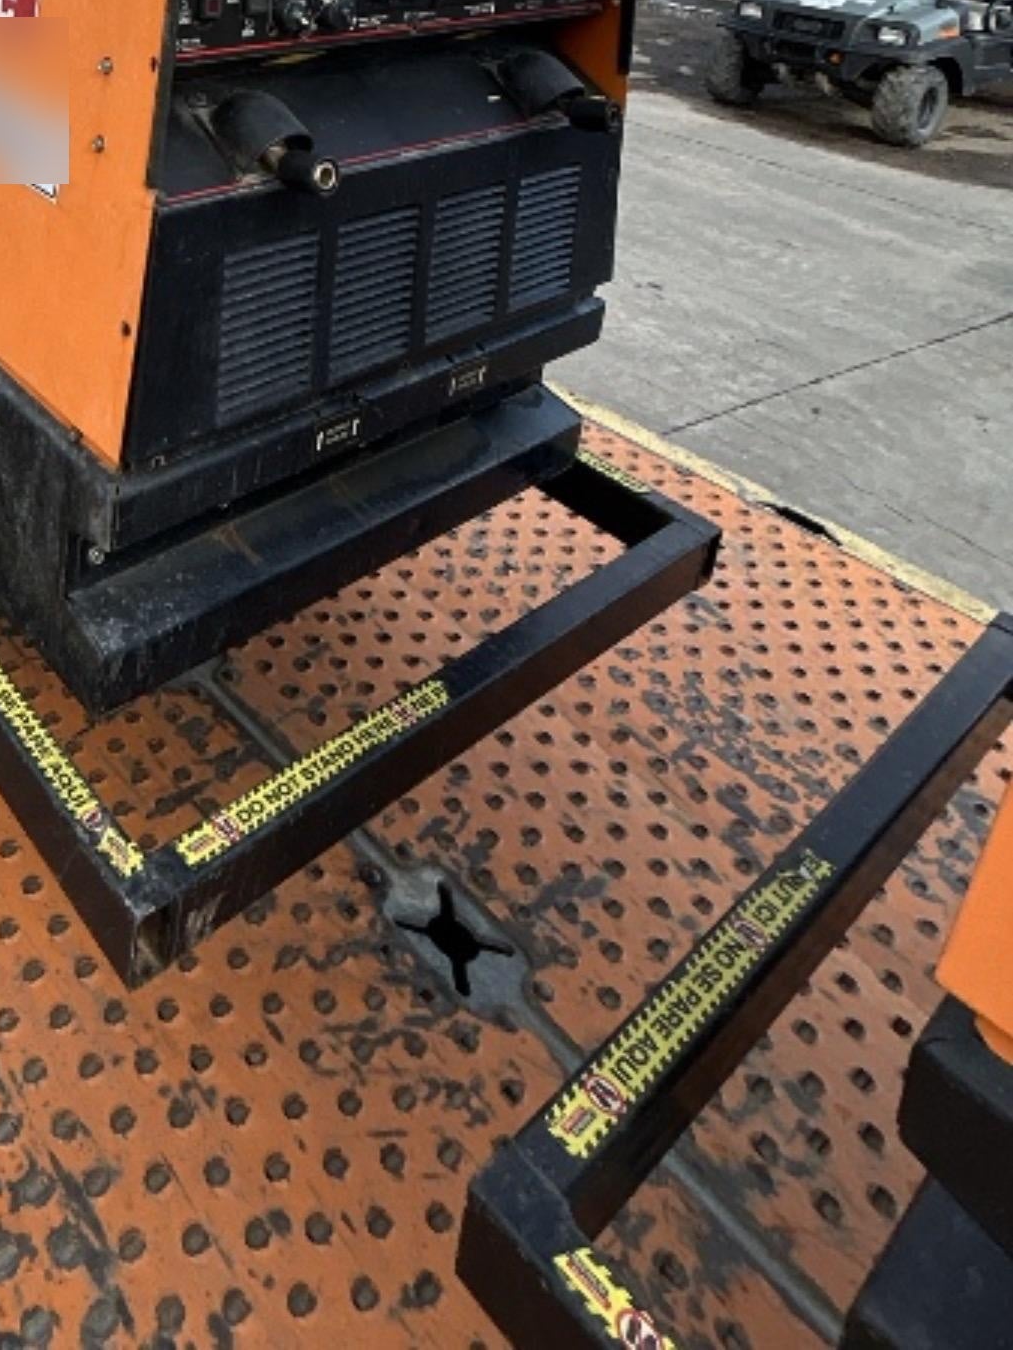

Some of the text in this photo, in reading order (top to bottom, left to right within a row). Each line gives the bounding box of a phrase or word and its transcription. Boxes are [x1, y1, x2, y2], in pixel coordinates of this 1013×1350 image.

[46, 760, 87, 809] AQUI
[236, 799, 265, 823] DO
[263, 773, 300, 806] NOT
[299, 739, 354, 781] STAND
[610, 940, 746, 1085] NO SE PARE AQUI
